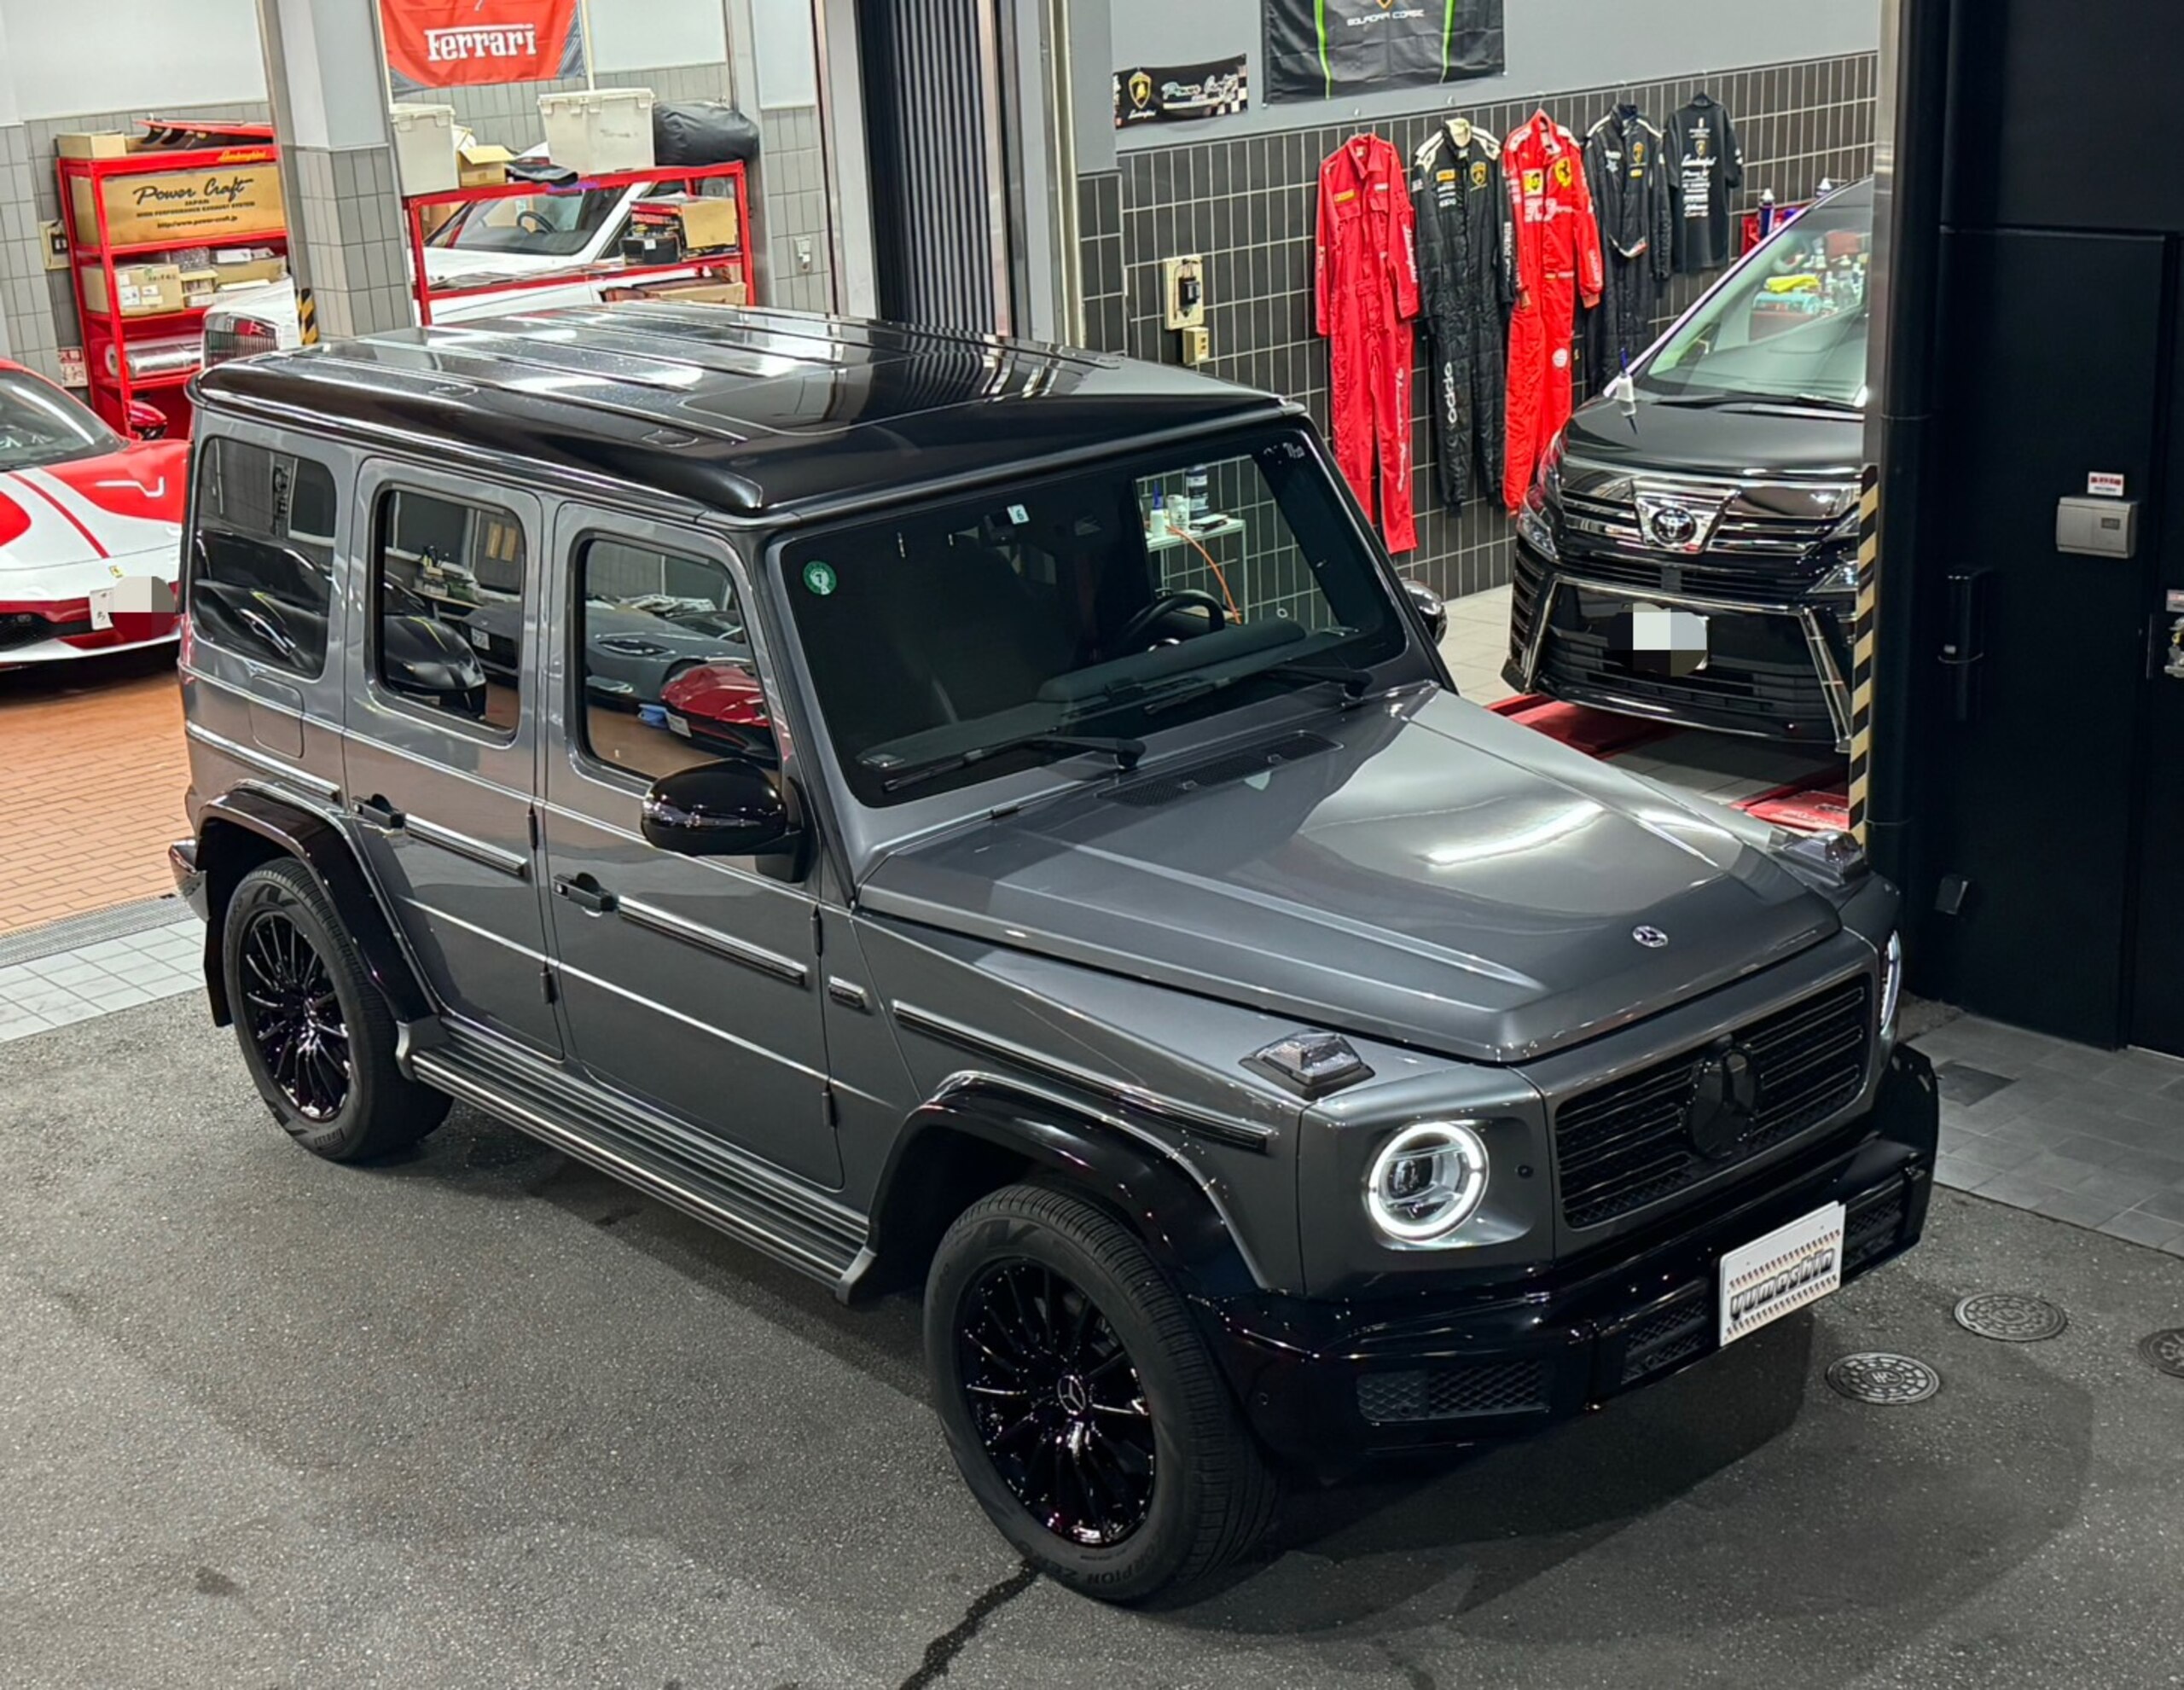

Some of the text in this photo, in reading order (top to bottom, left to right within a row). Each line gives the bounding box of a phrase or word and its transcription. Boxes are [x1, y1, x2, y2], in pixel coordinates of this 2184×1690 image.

[423, 23, 537, 62] Ferrari
[132, 176, 254, 206] Power Craft
[1729, 1246, 1835, 1321] yumeshin
